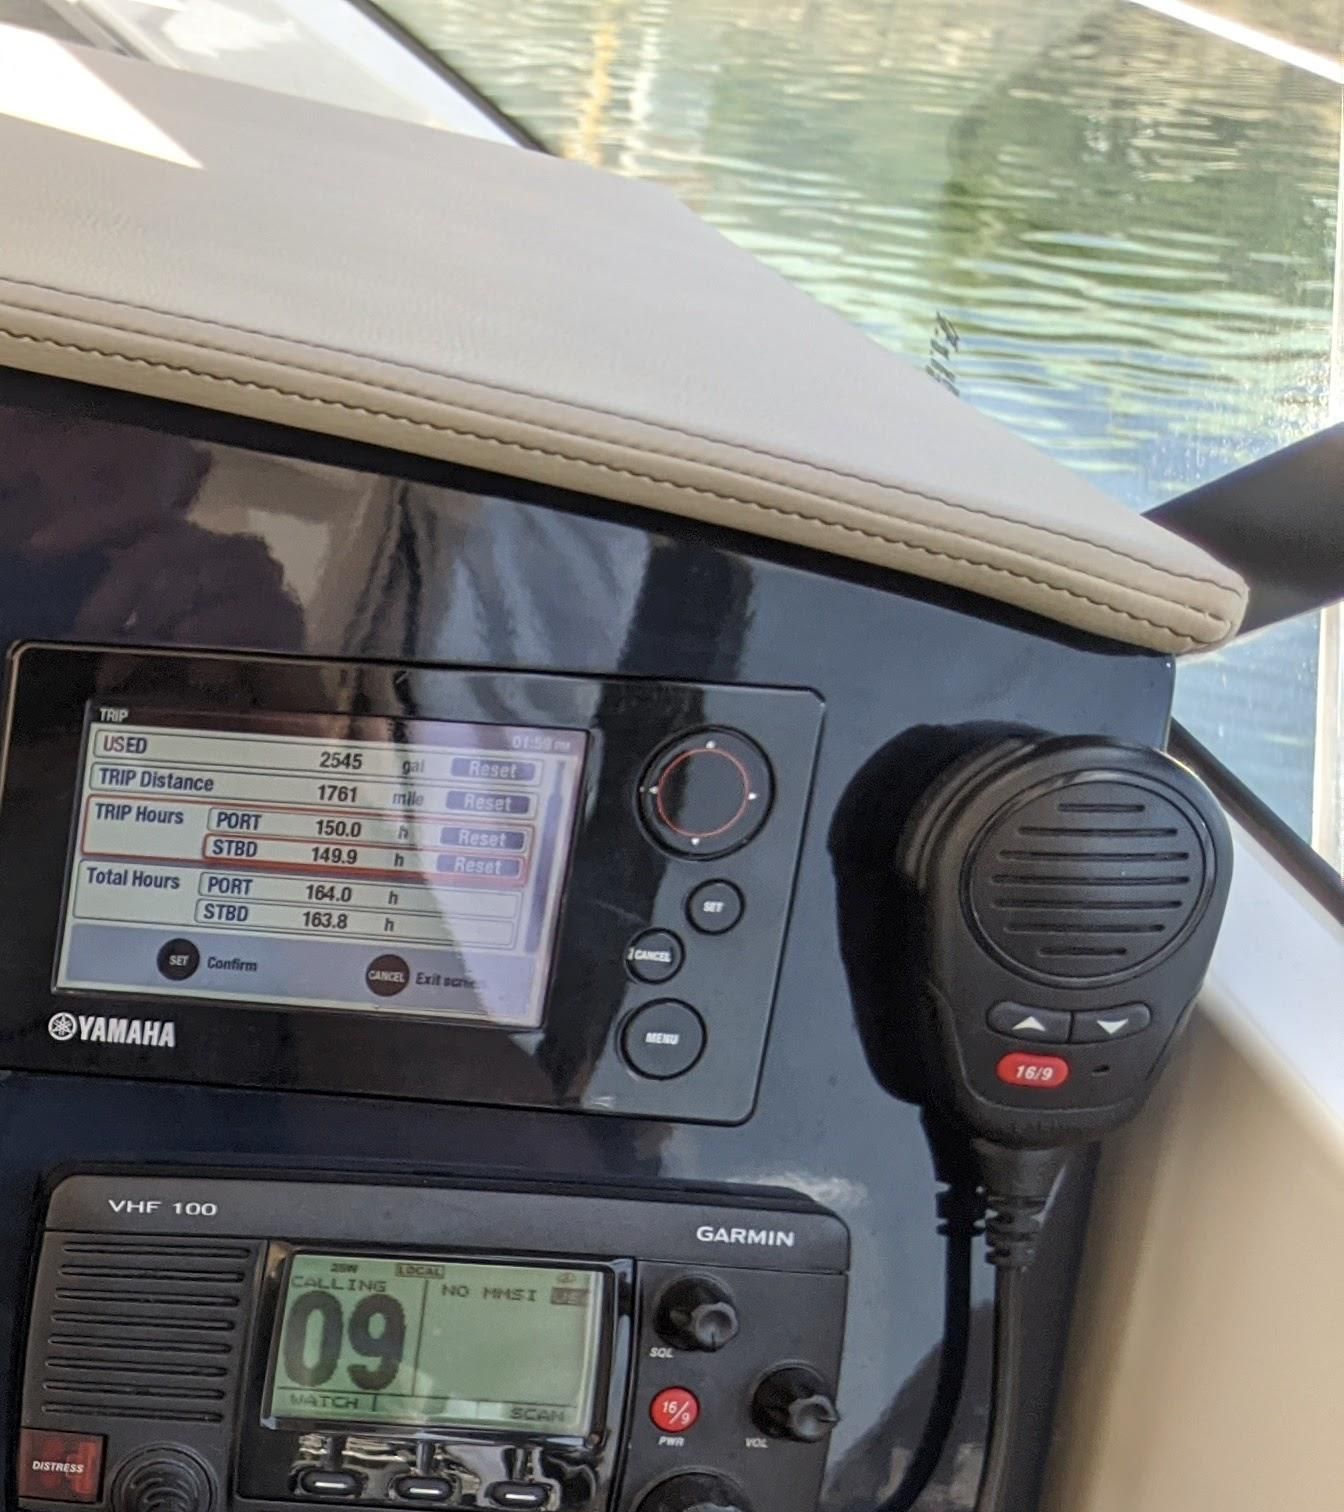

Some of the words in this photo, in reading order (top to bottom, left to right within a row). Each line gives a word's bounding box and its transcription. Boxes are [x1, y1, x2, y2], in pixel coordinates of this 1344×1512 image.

[99, 707, 129, 723] TRIP
[103, 736, 148, 755] USED
[319, 751, 363, 771] 2545
[402, 758, 425, 776] gal
[468, 760, 518, 780] Reset
[99, 767, 137, 787] TRIP
[140, 770, 215, 793] Distance
[317, 785, 359, 804] 1761
[392, 790, 424, 807] mile
[463, 793, 513, 813] Reset
[95, 803, 132, 822] TRIP
[135, 806, 185, 825] Hours
[216, 812, 262, 832] PORT
[315, 819, 362, 839] 150.0
[398, 825, 409, 840] h
[458, 827, 508, 848] Reset
[212, 839, 258, 859] STBD
[311, 847, 358, 866] 149.9
[394, 852, 404, 868] h
[453, 856, 503, 876] Reset
[86, 867, 128, 887] Total
[132, 870, 181, 890] Hours
[207, 876, 254, 896] PORT
[305, 884, 353, 904] 164.0
[388, 890, 398, 906] h
[203, 903, 249, 923] STBD
[302, 911, 348, 931] 163.8
[384, 918, 394, 933] h
[168, 954, 190, 968] SET
[207, 957, 258, 973] Confirm
[368, 970, 406, 984] CANCEL
[415, 972, 441, 987] Exit
[78, 1015, 176, 1048] YAMAHA
[644, 1032, 680, 1046] MENU
[1015, 1064, 1054, 1082] 16/9
[108, 1199, 161, 1215] VHF
[172, 1202, 218, 1217] 100
[696, 1226, 795, 1248] GARMIN
[398, 1265, 442, 1276] LOCAL
[290, 1275, 388, 1293] CALLING
[441, 1283, 469, 1298] NO
[483, 1287, 537, 1303] MMSI
[283, 1289, 407, 1392] 09
[649, 1347, 674, 1359] SQL
[290, 1395, 359, 1411] WATCH
[510, 1407, 564, 1423] SCAN
[658, 1436, 686, 1448] PWR
[745, 1438, 770, 1449] VOL
[32, 1460, 85, 1474] DISTRESS
